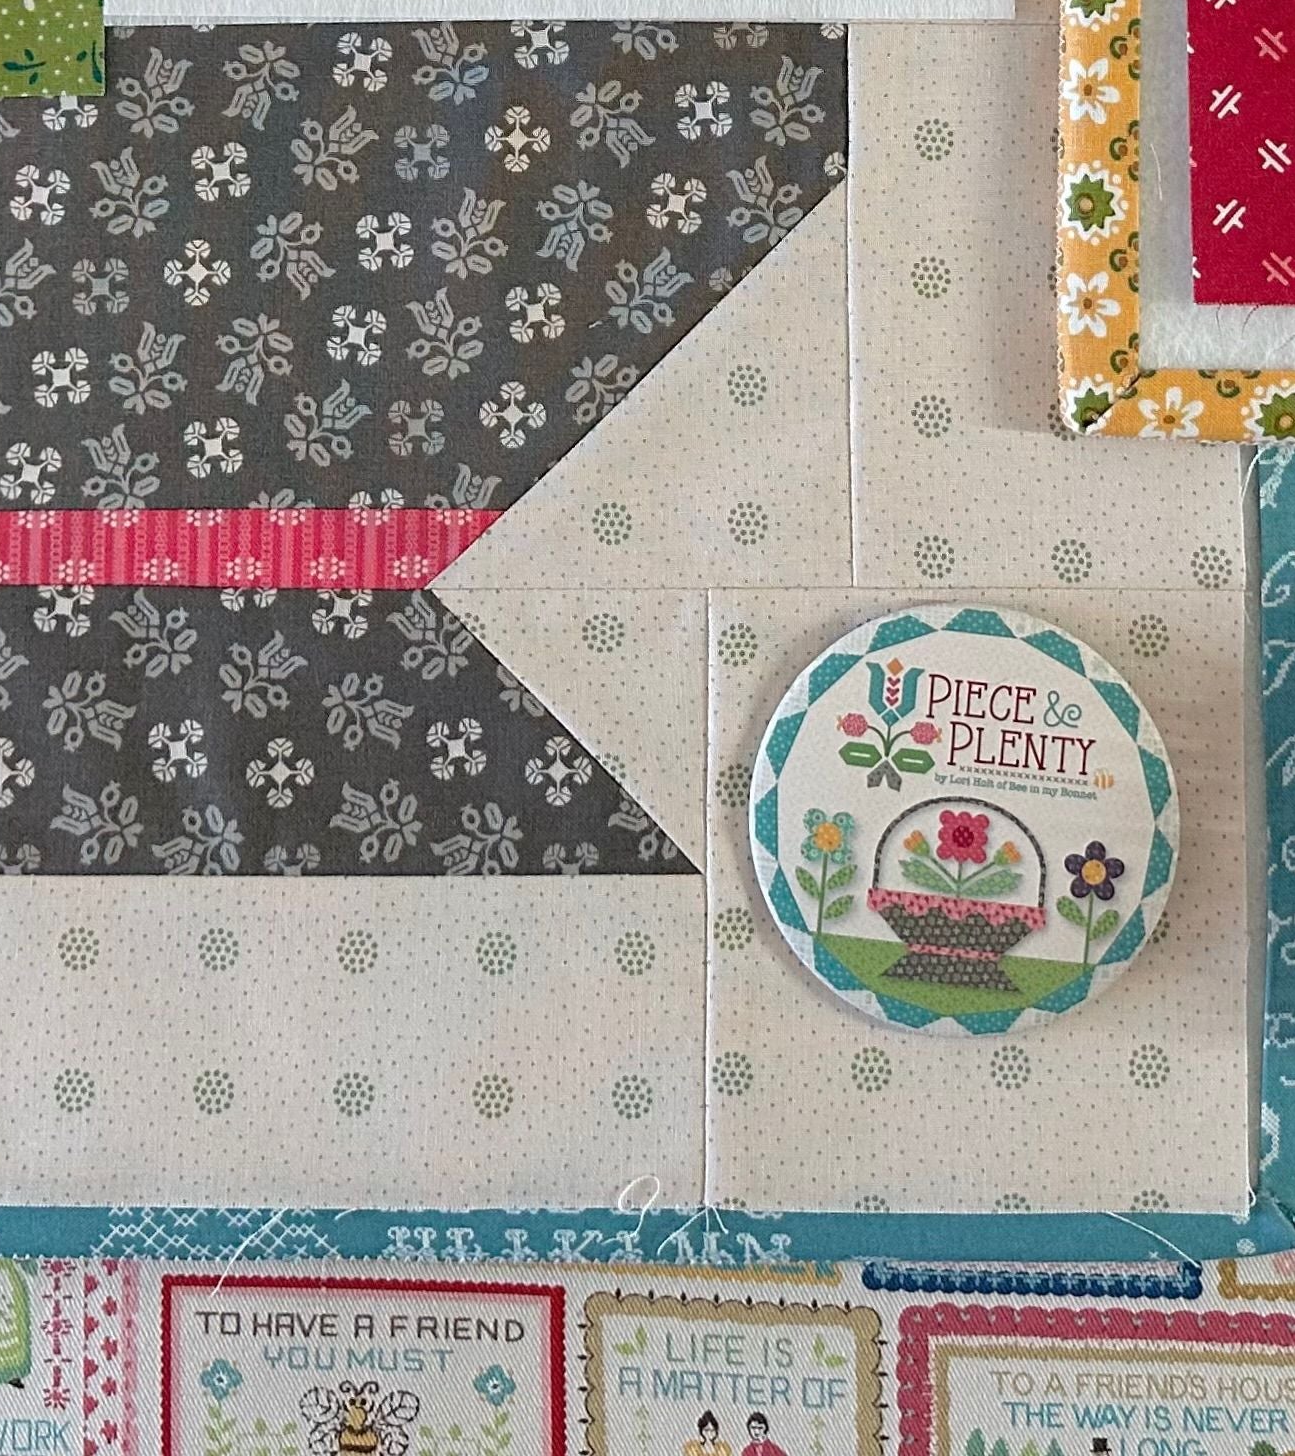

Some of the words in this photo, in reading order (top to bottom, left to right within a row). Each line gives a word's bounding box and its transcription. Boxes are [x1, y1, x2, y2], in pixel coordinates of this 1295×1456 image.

[926, 674, 1037, 724] PIECE
[1043, 690, 1082, 729] &
[947, 721, 1097, 776] PLENTY
[949, 774, 971, 786] Lori
[666, 1332, 746, 1365] LIFE
[763, 1336, 794, 1367] IS
[618, 1367, 641, 1397] A
[653, 1371, 791, 1406] MATTER
[803, 1376, 848, 1408] OF
